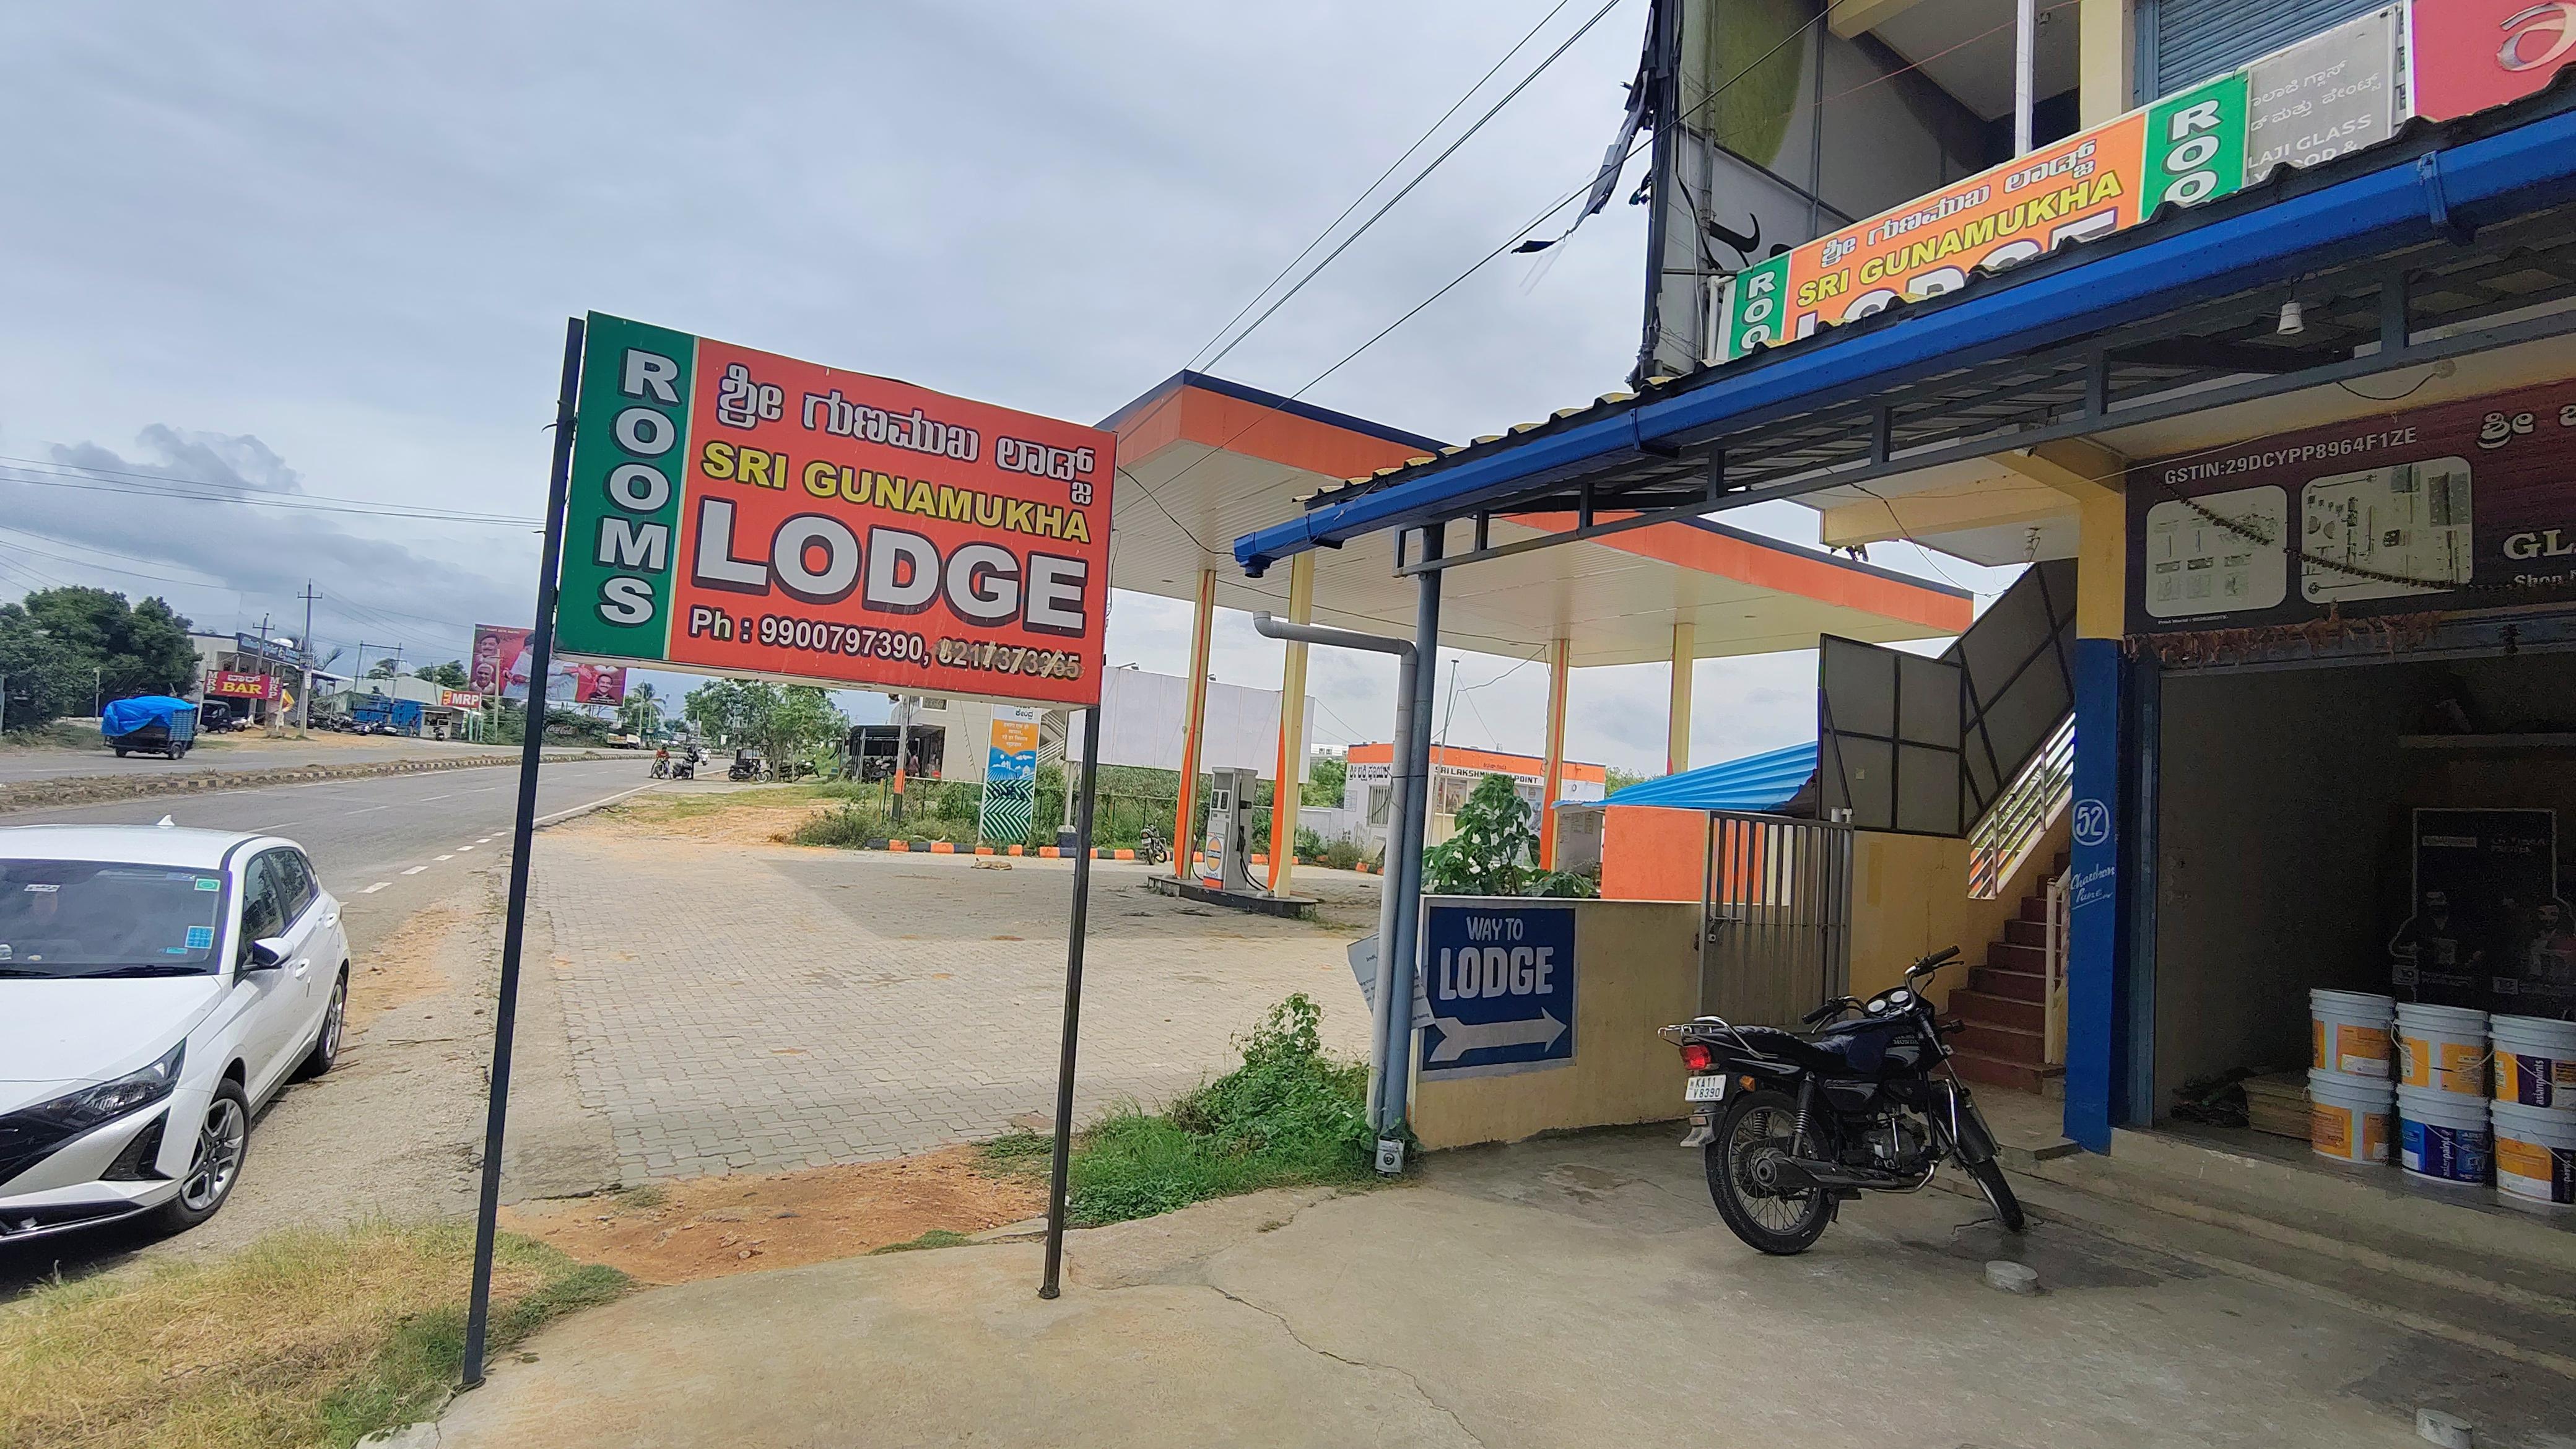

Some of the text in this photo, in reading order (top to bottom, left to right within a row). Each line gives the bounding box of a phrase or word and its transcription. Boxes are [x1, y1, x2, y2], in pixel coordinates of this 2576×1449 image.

[2272, 100, 2312, 123] ಮತ್ತು
[2296, 113, 2372, 150] GLASS
[1797, 268, 1850, 307] SRI
[1860, 170, 2123, 285] GUNAMUKHA
[1821, 238, 1856, 268] ಶ್ರೀ
[1868, 185, 1990, 246] ಗುಣಮುಖ
[718, 363, 1095, 505] ಶ್ರೀ ಗುಣಮುಖ ಲಾಡ್ಜ್
[2477, 412, 2535, 449] ಶ್ರೀ
[598, 348, 680, 624] ROOMS
[703, 442, 1089, 543] SRI GUNAMUKHA
[2504, 529, 2576, 560] GL
[695, 499, 1087, 630] LODGE
[691, 607, 731, 638] Ph
[761, 617, 929, 665] 9900797390,
[221, 682, 263, 694] BAR
[452, 693, 479, 705] MRP
[1514, 775, 1538, 784] POINT
[2076, 806, 2104, 836] 52
[1466, 916, 1523, 941] WAY TO
[1439, 946, 1554, 1000] LODGE
